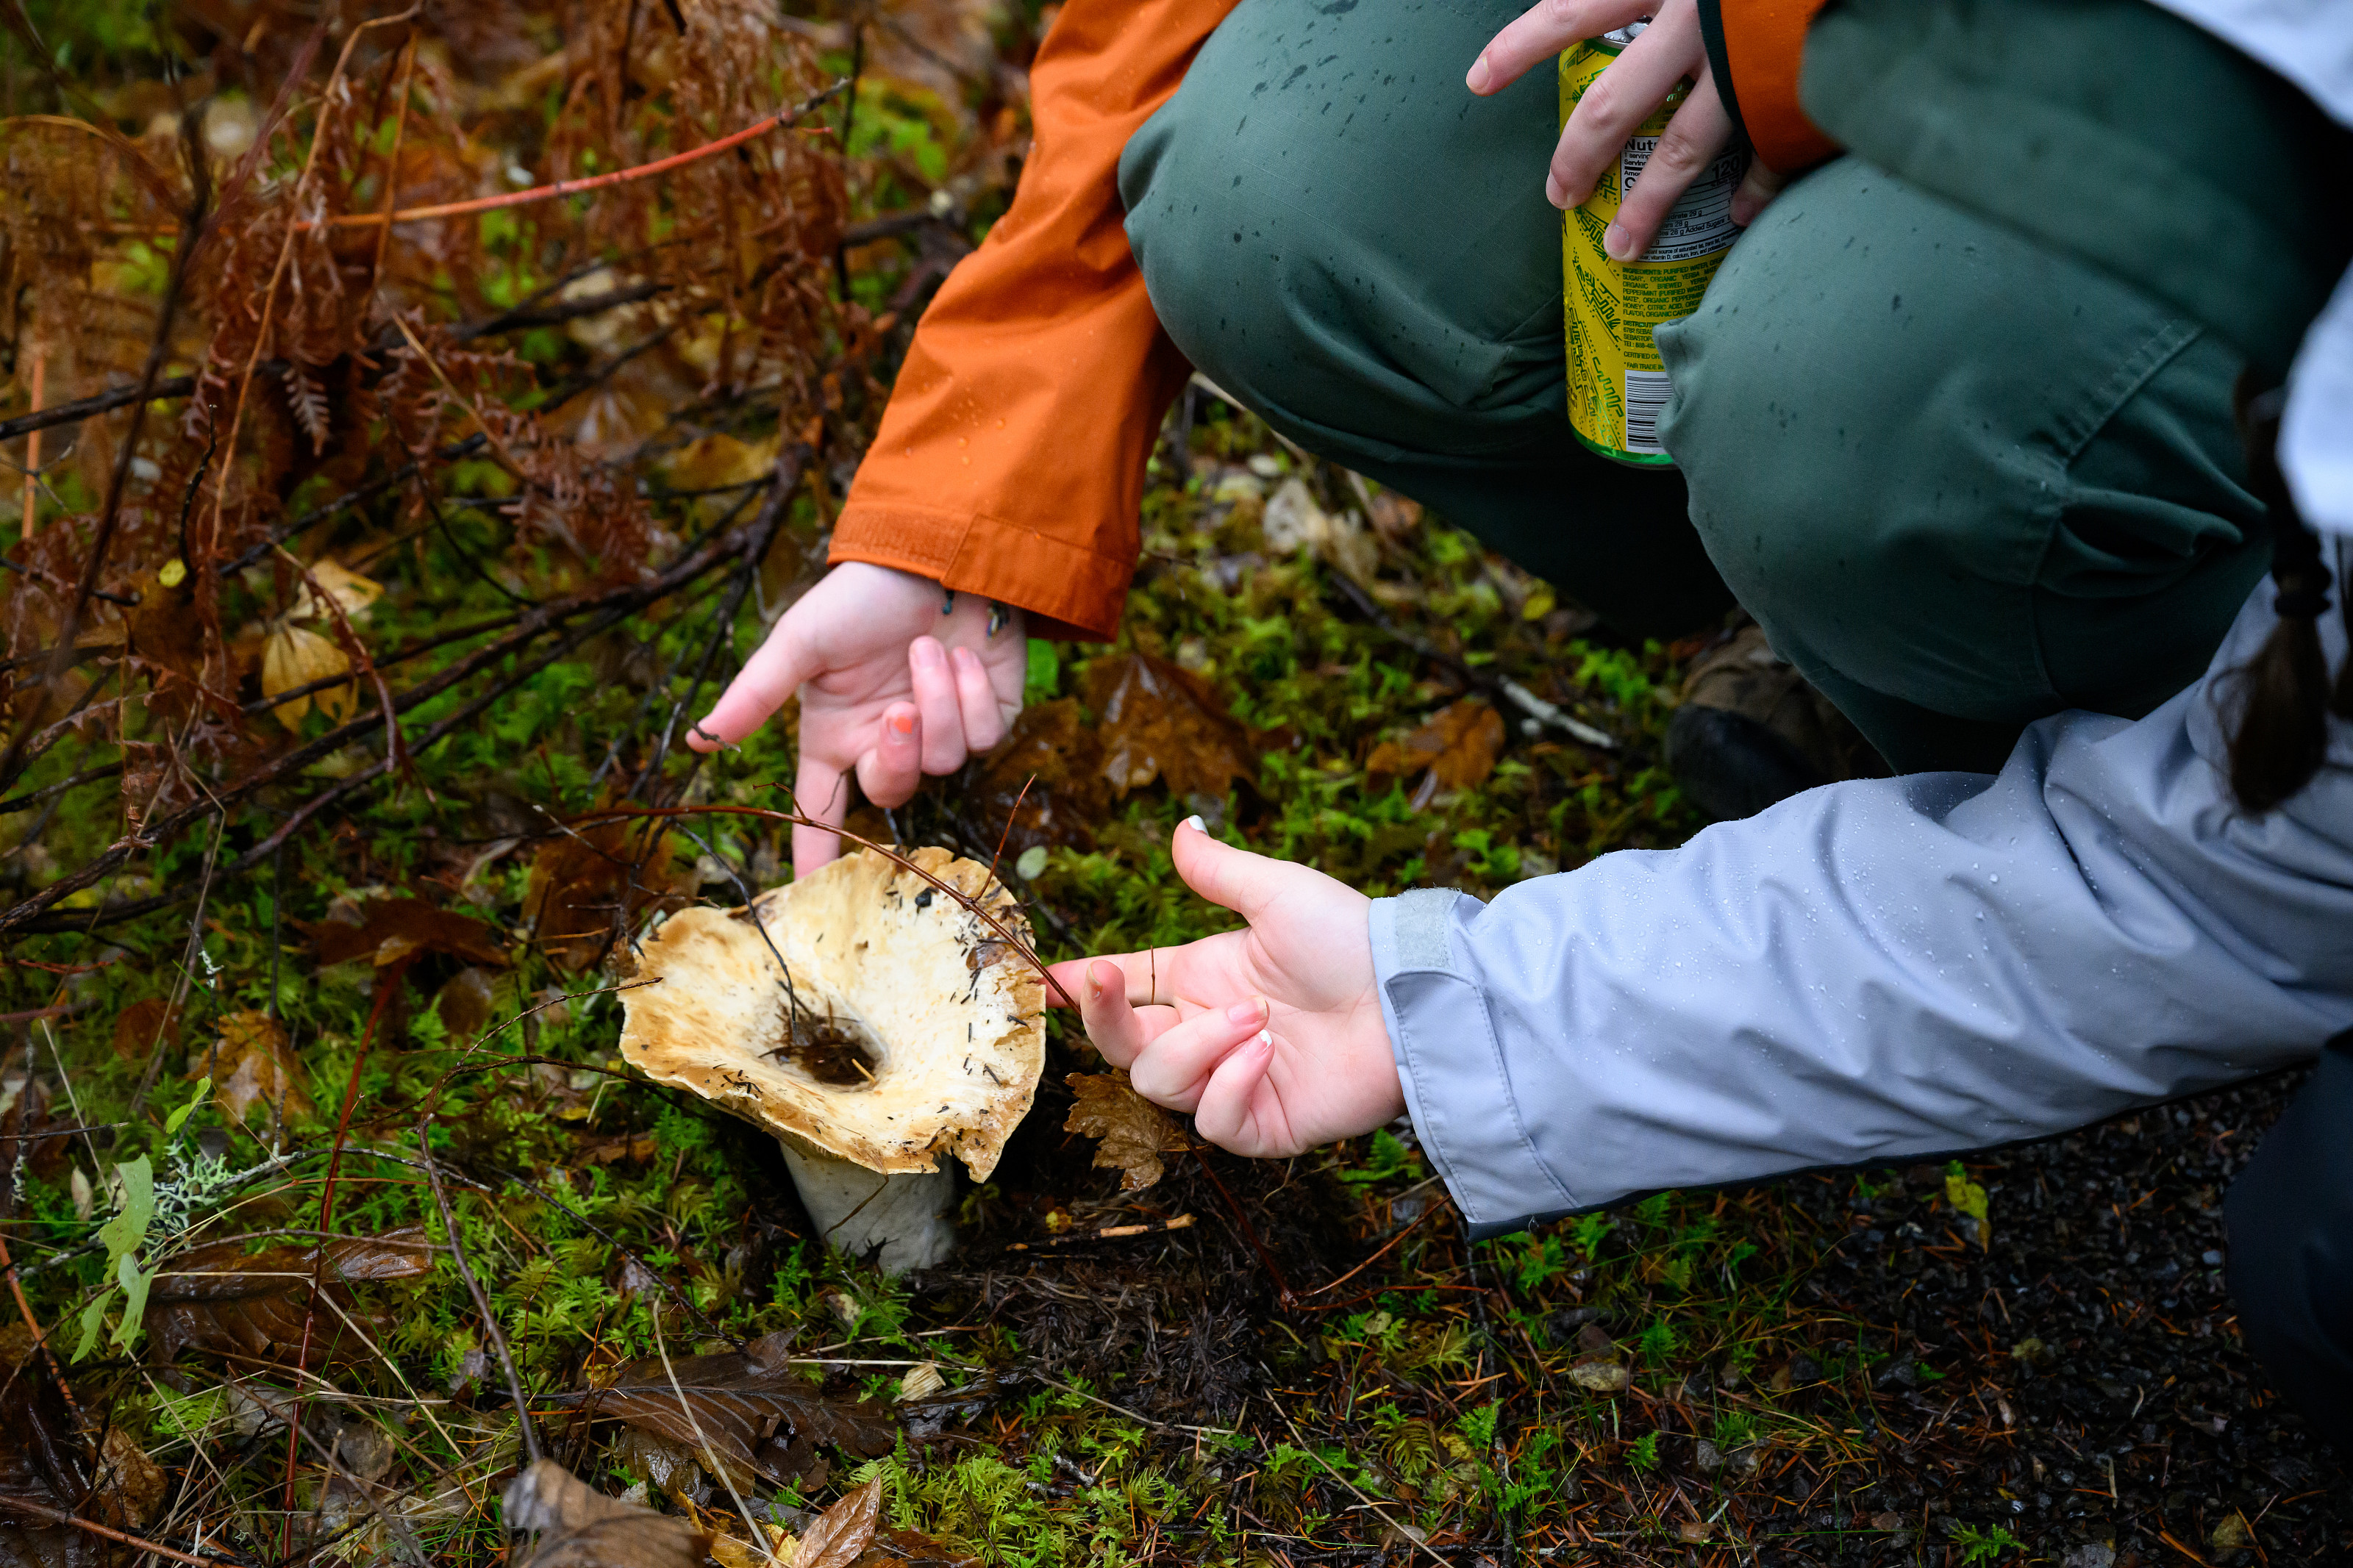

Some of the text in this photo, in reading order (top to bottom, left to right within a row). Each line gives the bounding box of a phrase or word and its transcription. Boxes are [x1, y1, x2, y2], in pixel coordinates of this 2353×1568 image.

[1712, 155, 1740, 179] 120
[1685, 224, 1705, 233] Added
[1706, 218, 1725, 229] Sugars
[1622, 267, 1662, 275] INGREDIENTS:
[1663, 266, 1689, 275] PURIFIED
[1681, 271, 1699, 280] YERBA
[1622, 276, 1708, 290] ORGANIC BREWED YERBA
[1622, 287, 1657, 296] PEPPERMINT
[1623, 309, 1646, 318] FLAVOR,
[1624, 351, 1651, 359] CERTIFIED
